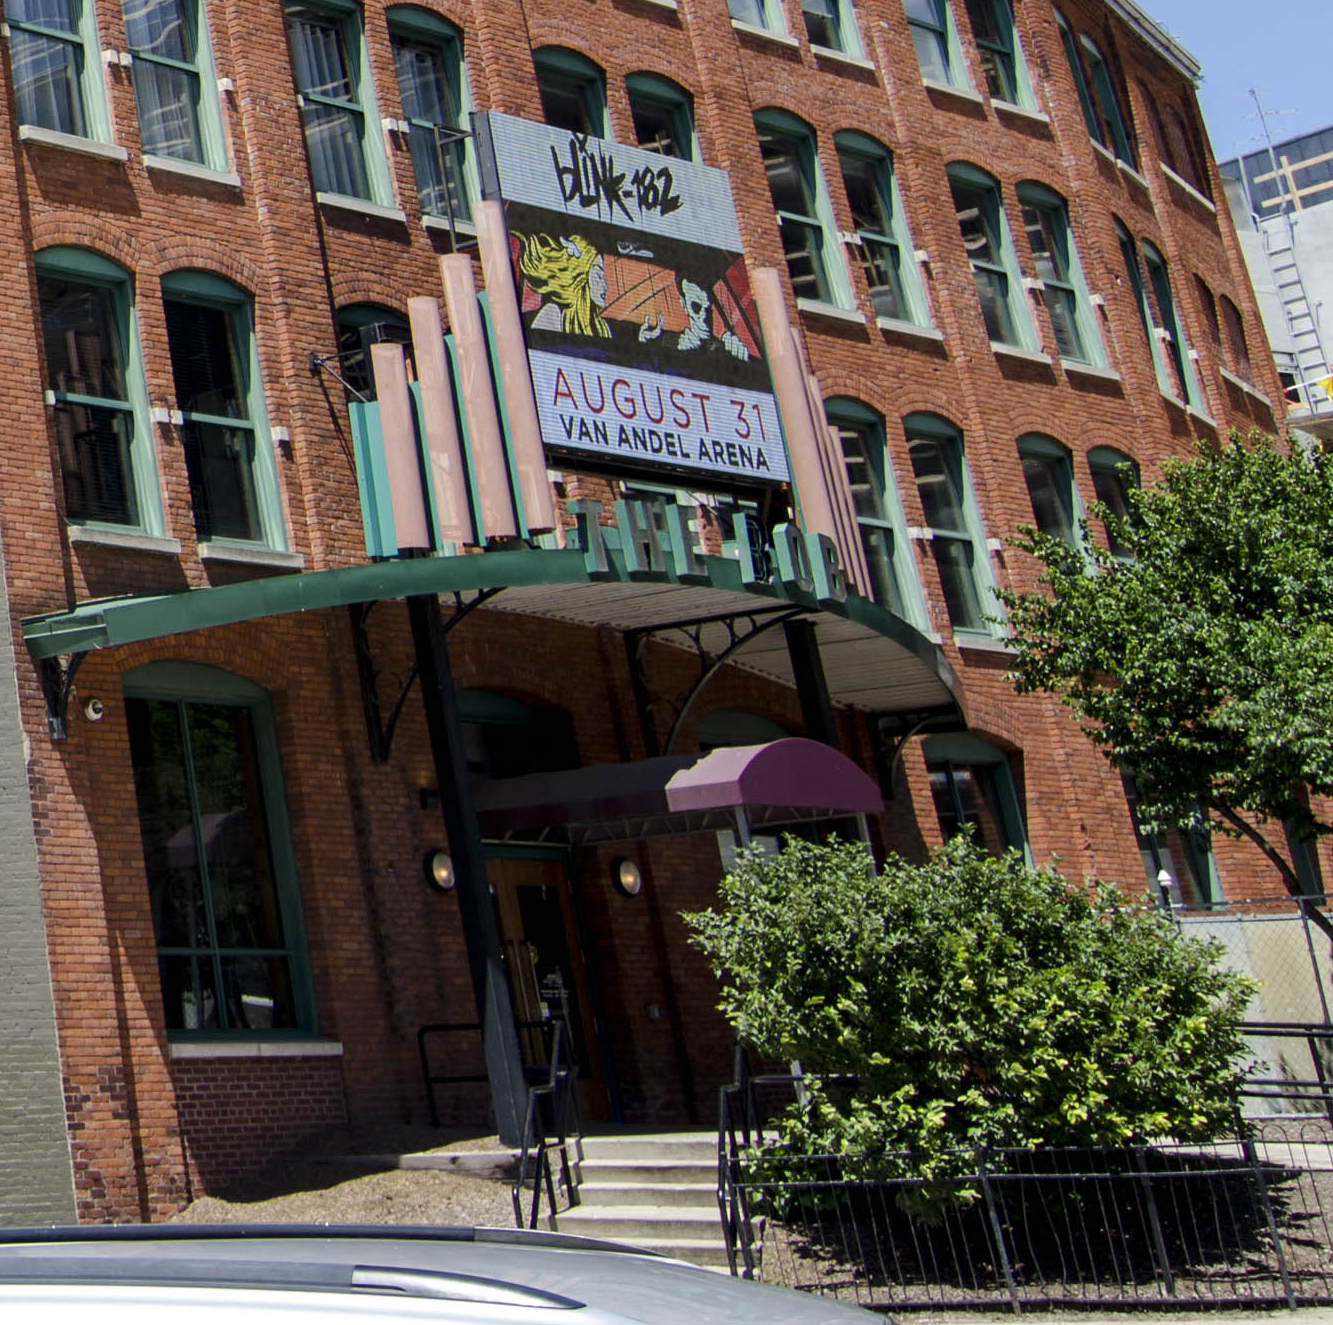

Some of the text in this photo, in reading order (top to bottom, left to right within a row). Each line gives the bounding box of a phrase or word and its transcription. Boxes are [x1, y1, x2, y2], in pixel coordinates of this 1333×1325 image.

[553, 367, 766, 442] AUGUST 31
[559, 414, 770, 472] VAN ANDEL ARENA
[568, 499, 709, 576] THE
